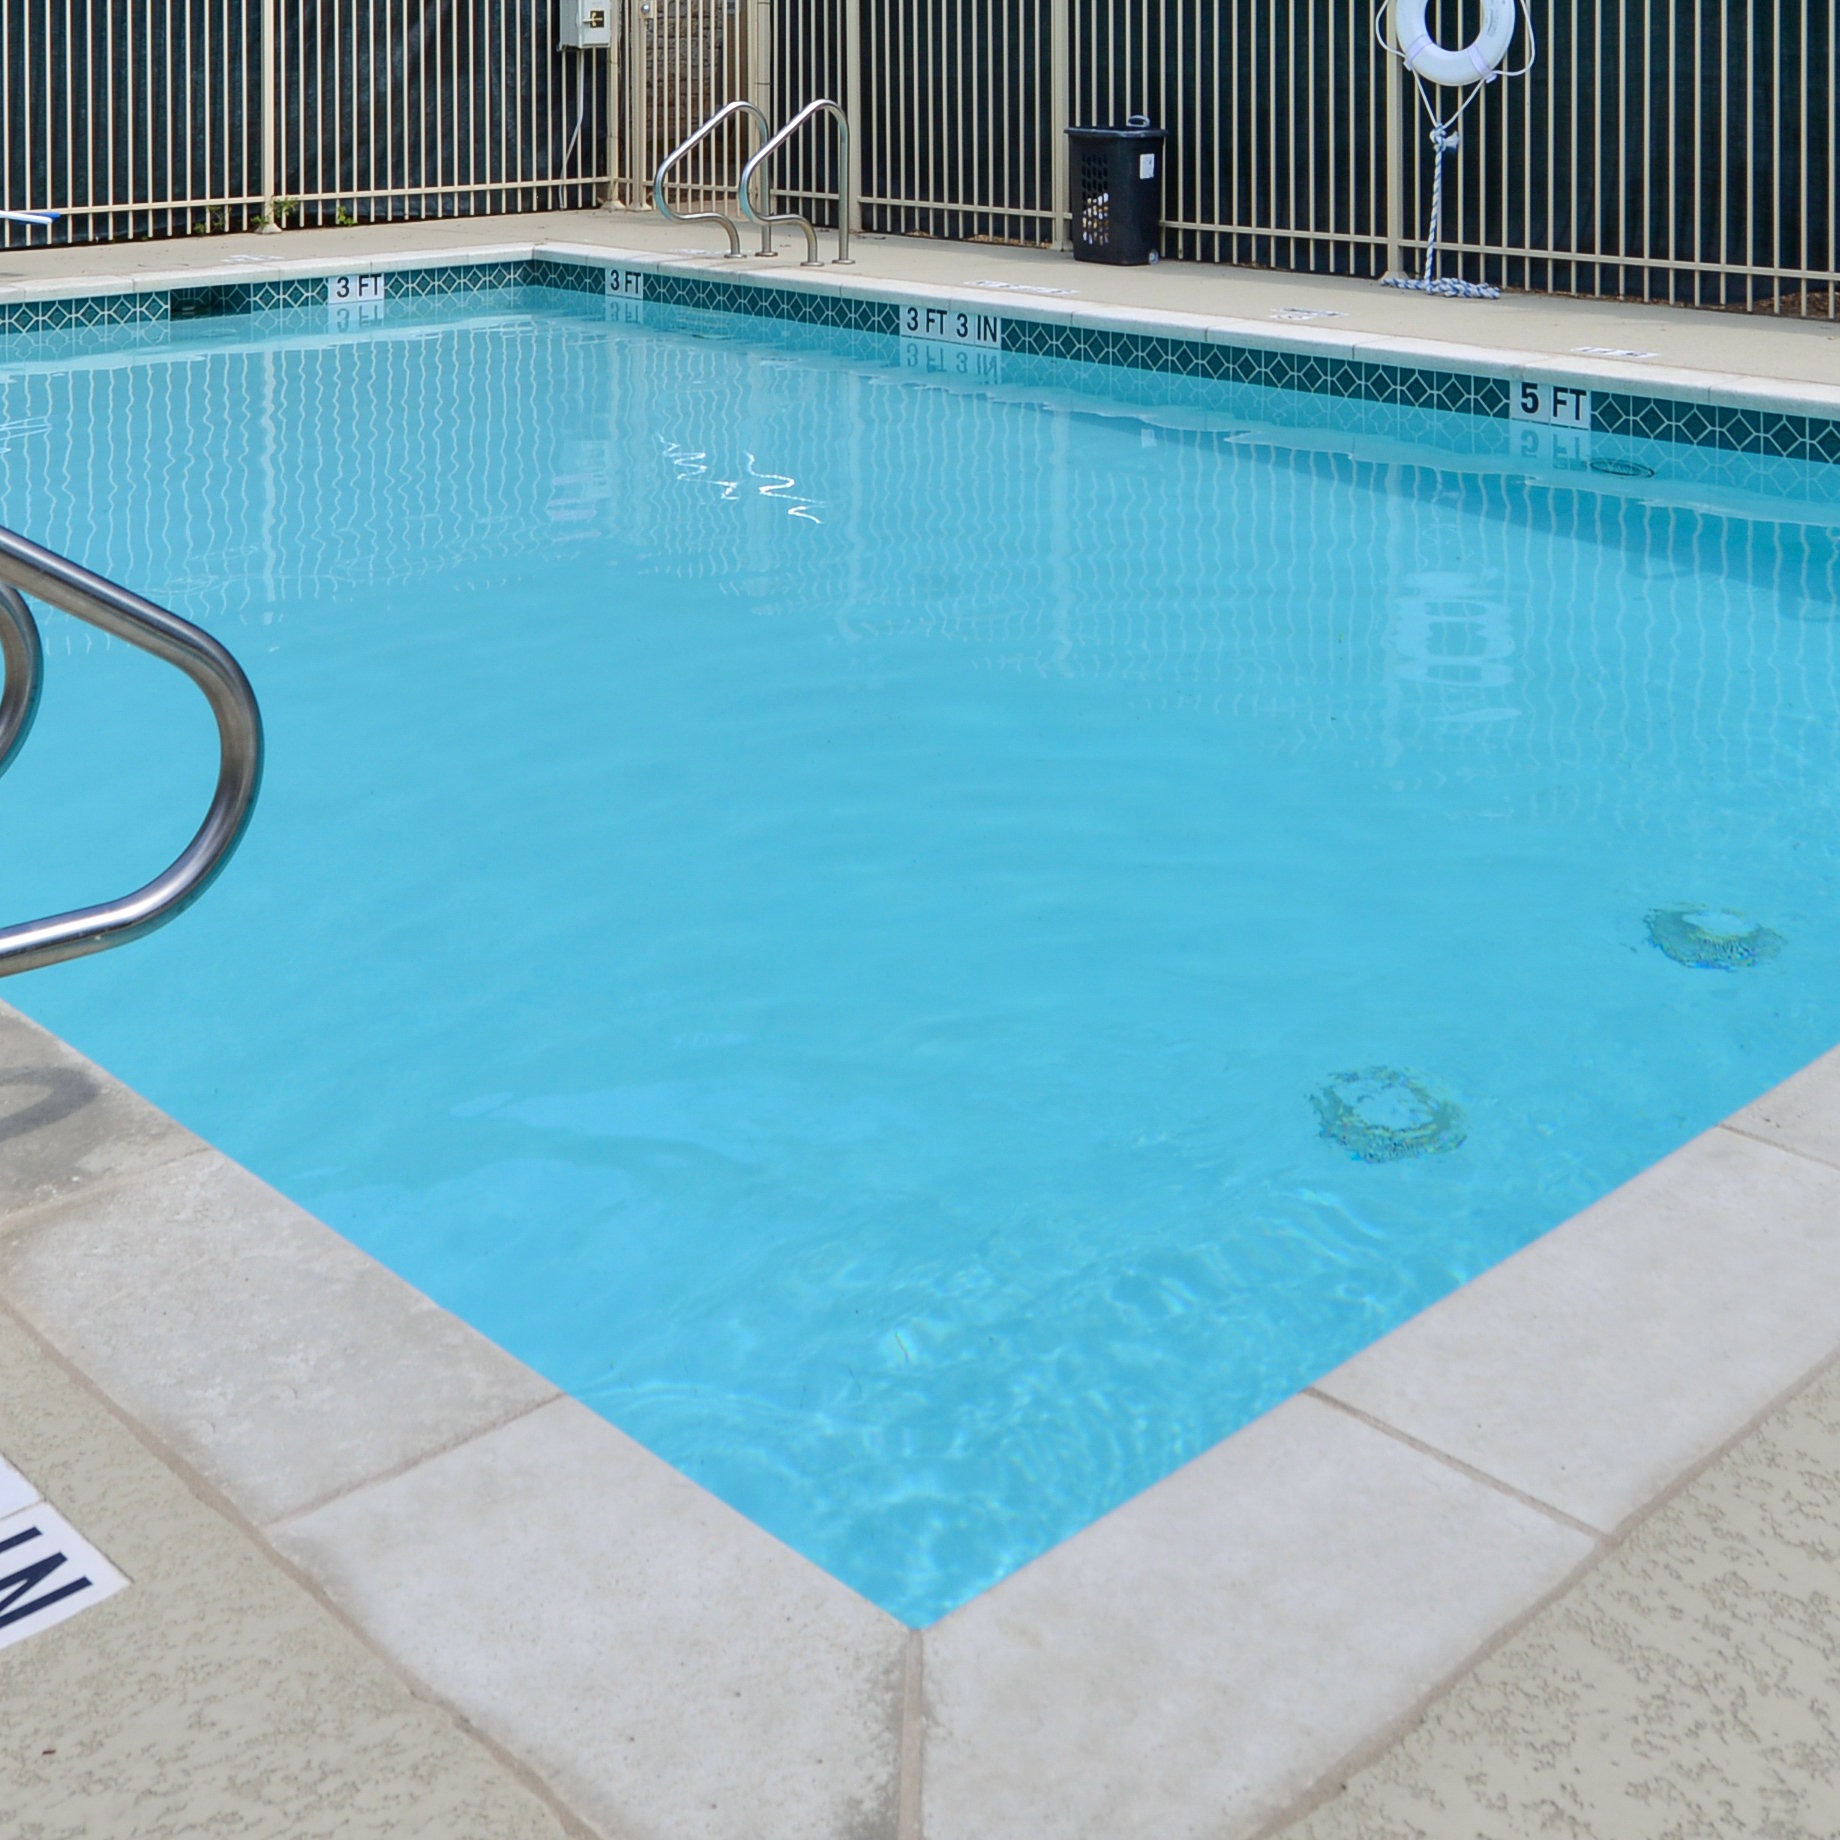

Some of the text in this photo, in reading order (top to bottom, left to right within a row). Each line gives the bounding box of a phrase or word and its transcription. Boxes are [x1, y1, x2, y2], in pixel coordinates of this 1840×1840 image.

[337, 274, 381, 298] 3 FT
[611, 270, 641, 294] 3 FT
[907, 307, 997, 342] 3 FT 3 IN
[1521, 382, 1587, 421] 5 FT
